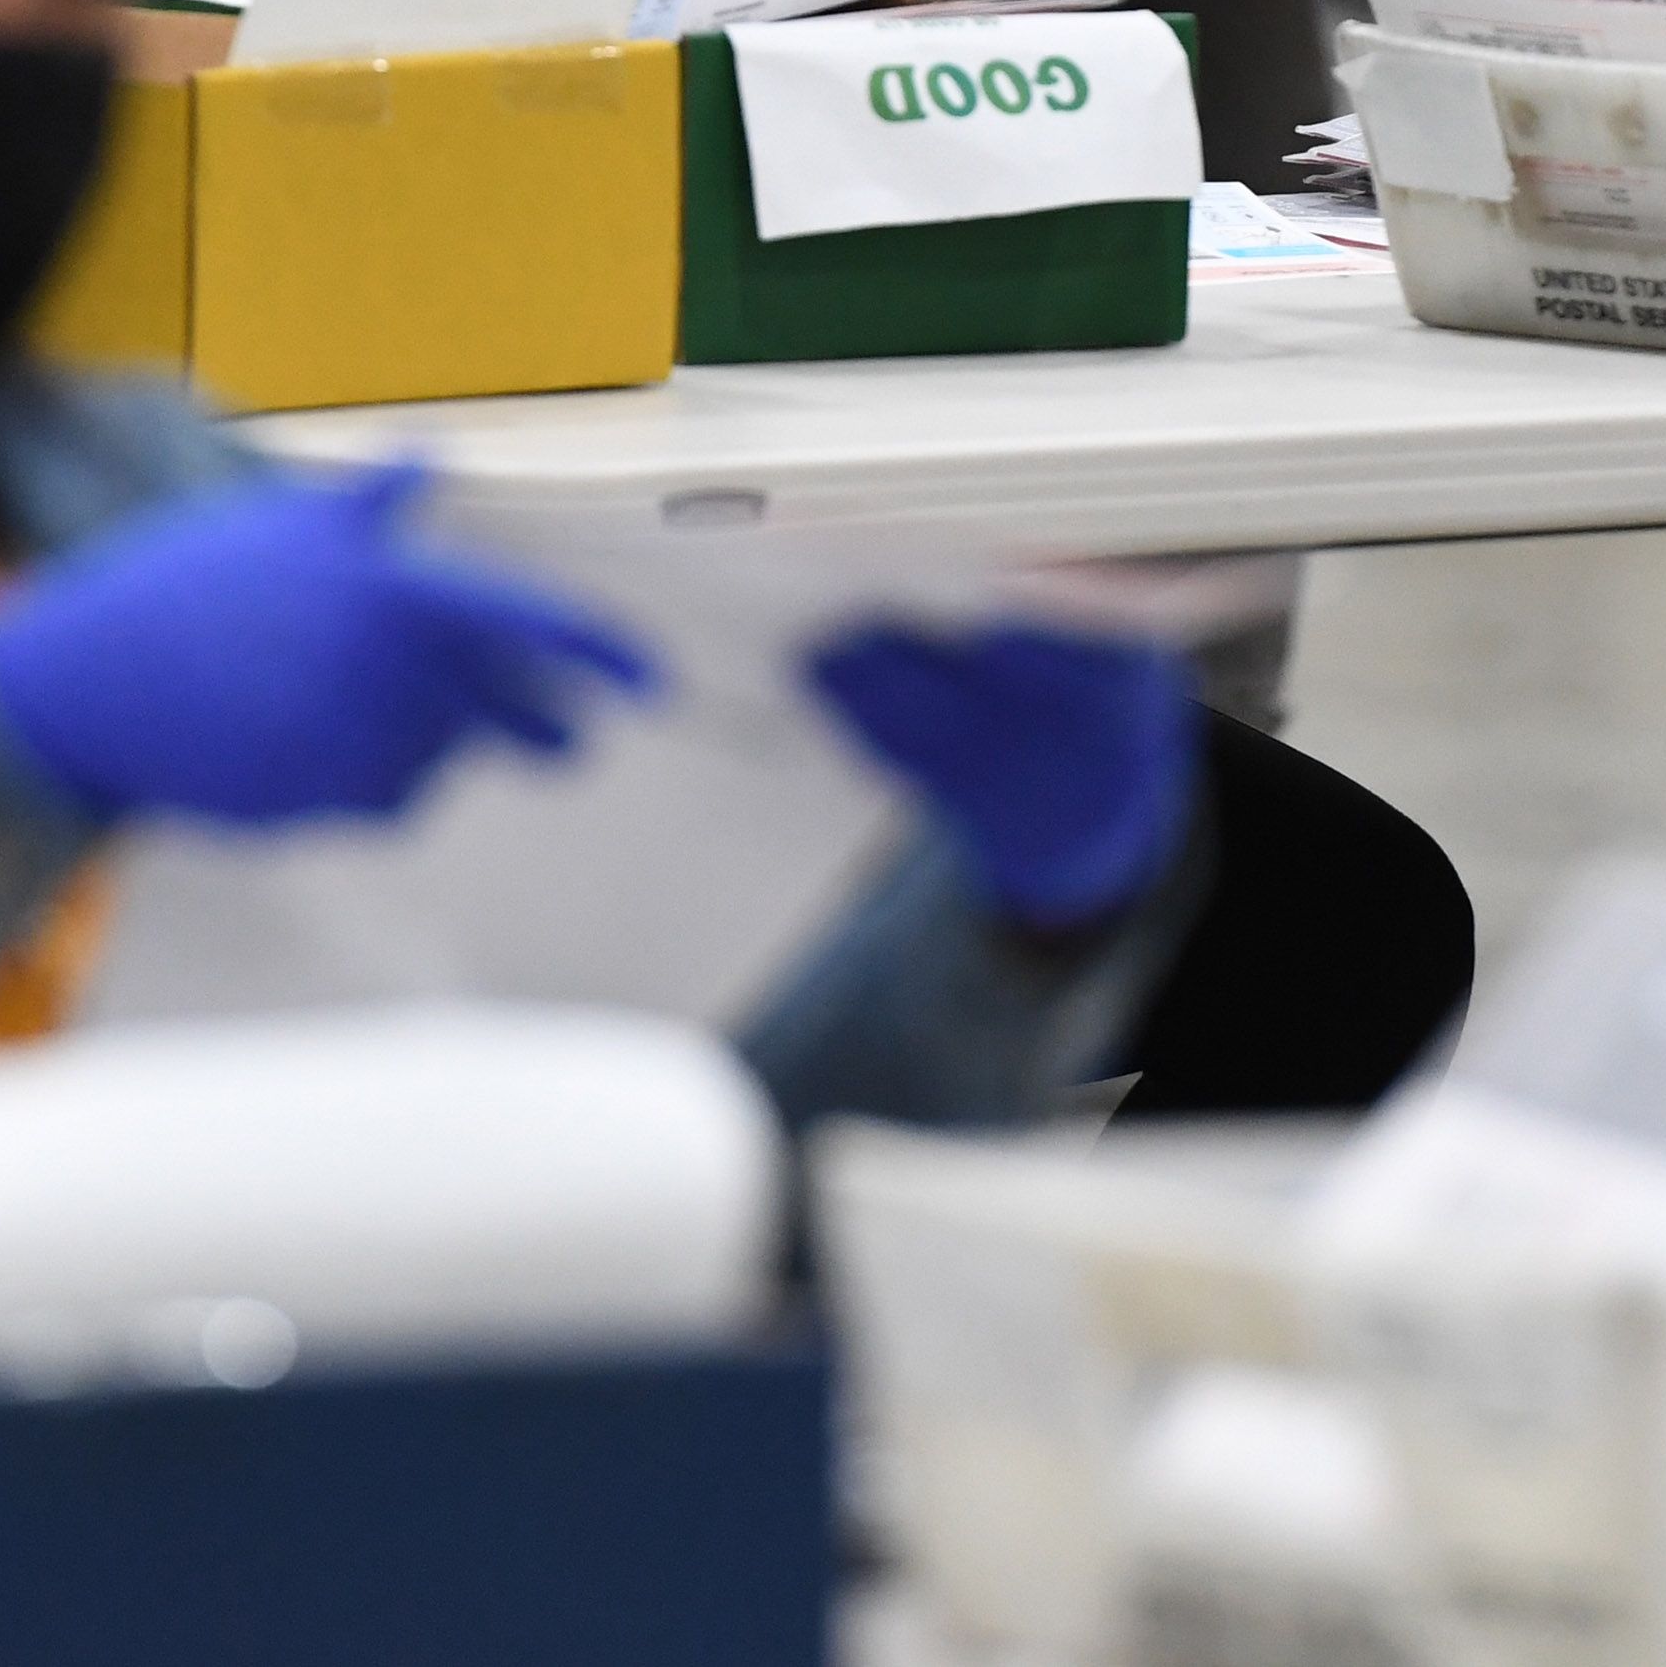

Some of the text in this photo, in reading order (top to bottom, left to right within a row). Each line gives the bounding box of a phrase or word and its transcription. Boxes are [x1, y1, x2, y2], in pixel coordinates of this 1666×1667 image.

[868, 54, 1090, 122] GOOD
[1533, 268, 1616, 294] UNITED
[1536, 297, 1626, 325] POSTAL
